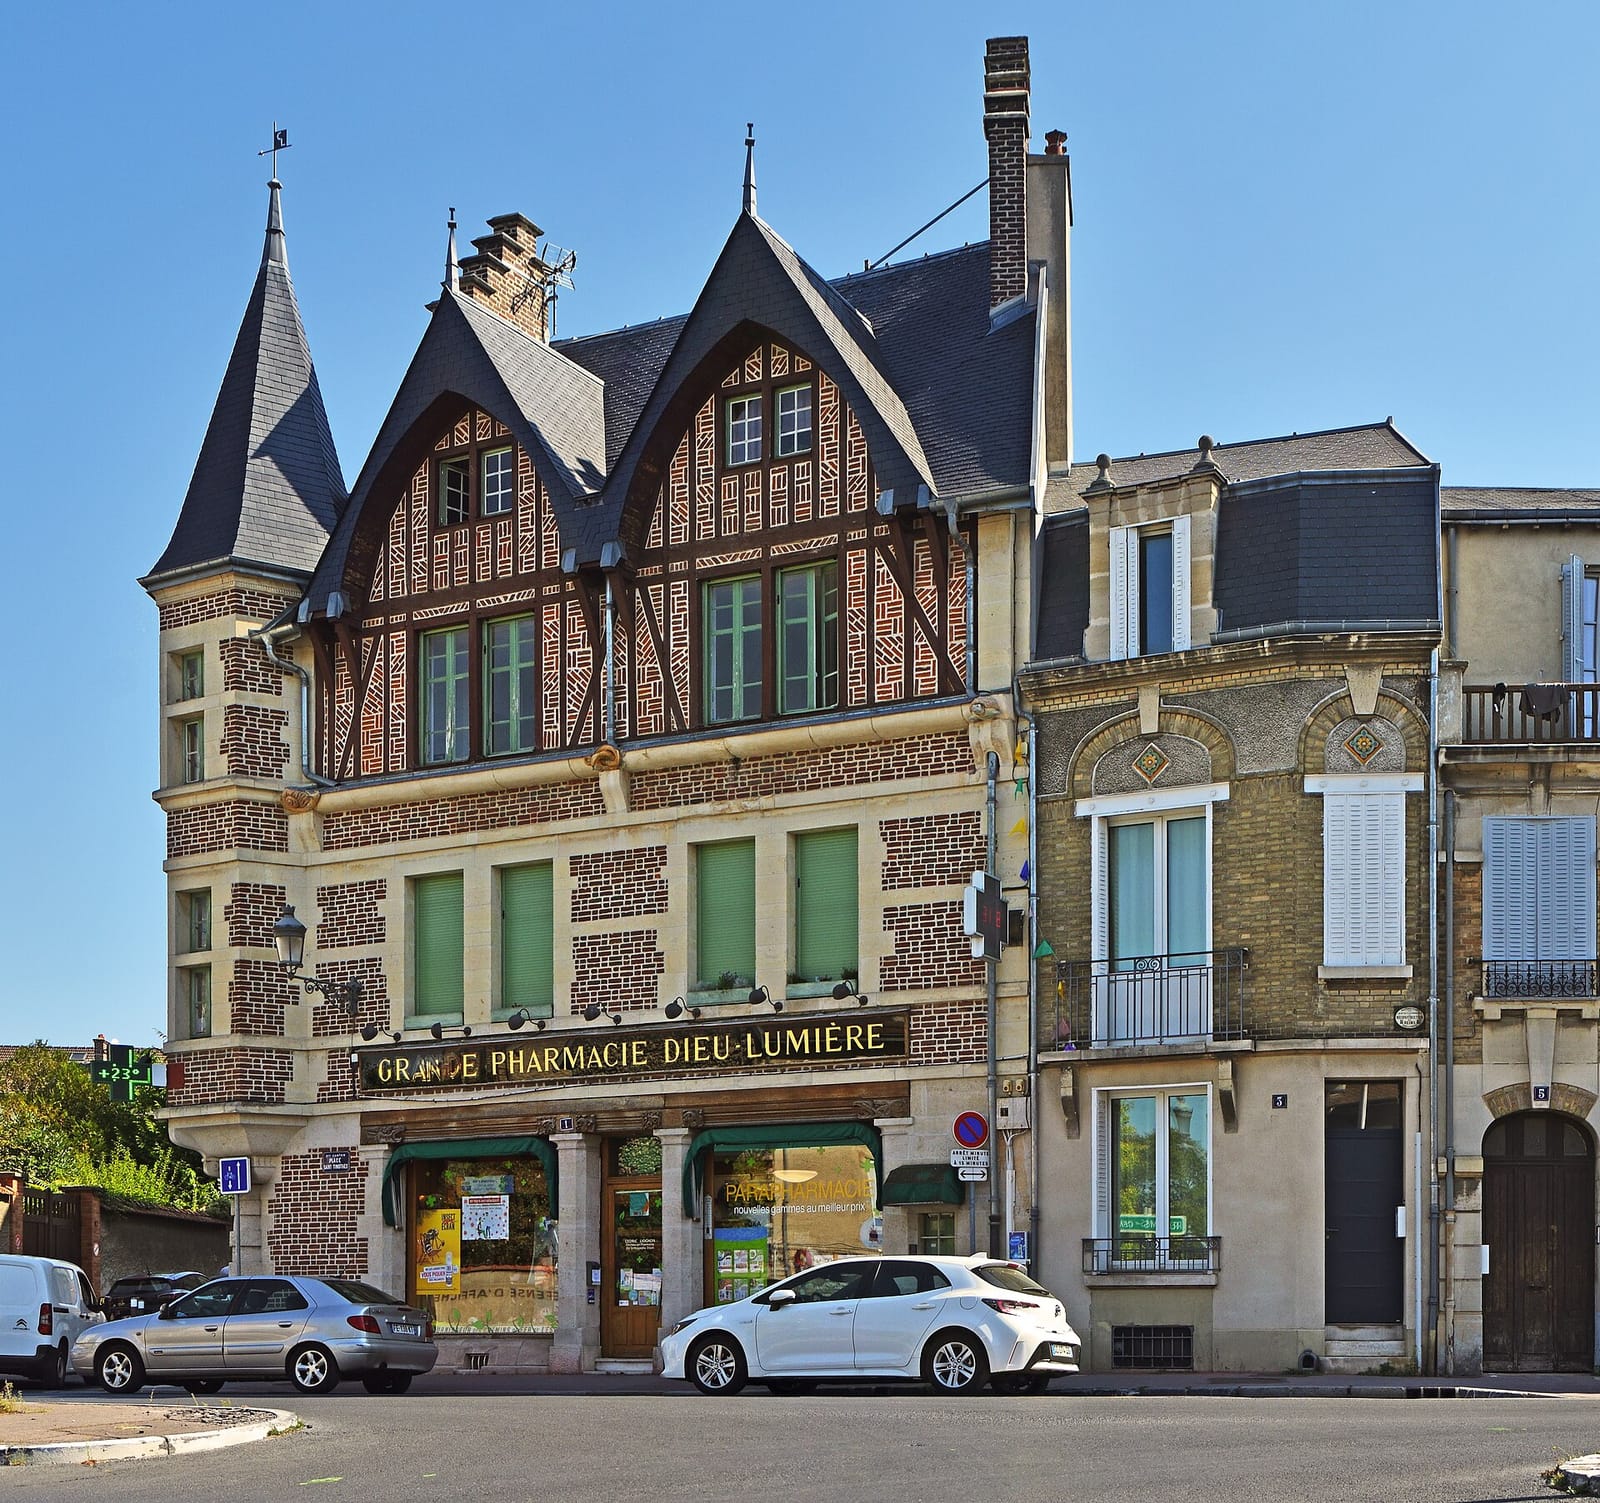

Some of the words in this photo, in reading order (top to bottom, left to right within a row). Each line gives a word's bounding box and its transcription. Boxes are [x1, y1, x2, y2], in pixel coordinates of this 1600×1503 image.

[378, 1053, 478, 1082] GRANDE
[492, 1041, 647, 1075] PHARMACIE
[1538, 1088, 1545, 1099] 5
[1276, 1096, 1283, 1107] 3
[726, 1179, 873, 1202] PARAPHARMACIE
[733, 1204, 770, 1215] nouvelles
[770, 1205, 805, 1216] gammes
[806, 1205, 817, 1213] au
[818, 1203, 850, 1212] meilleur
[851, 1202, 866, 1213] prix
